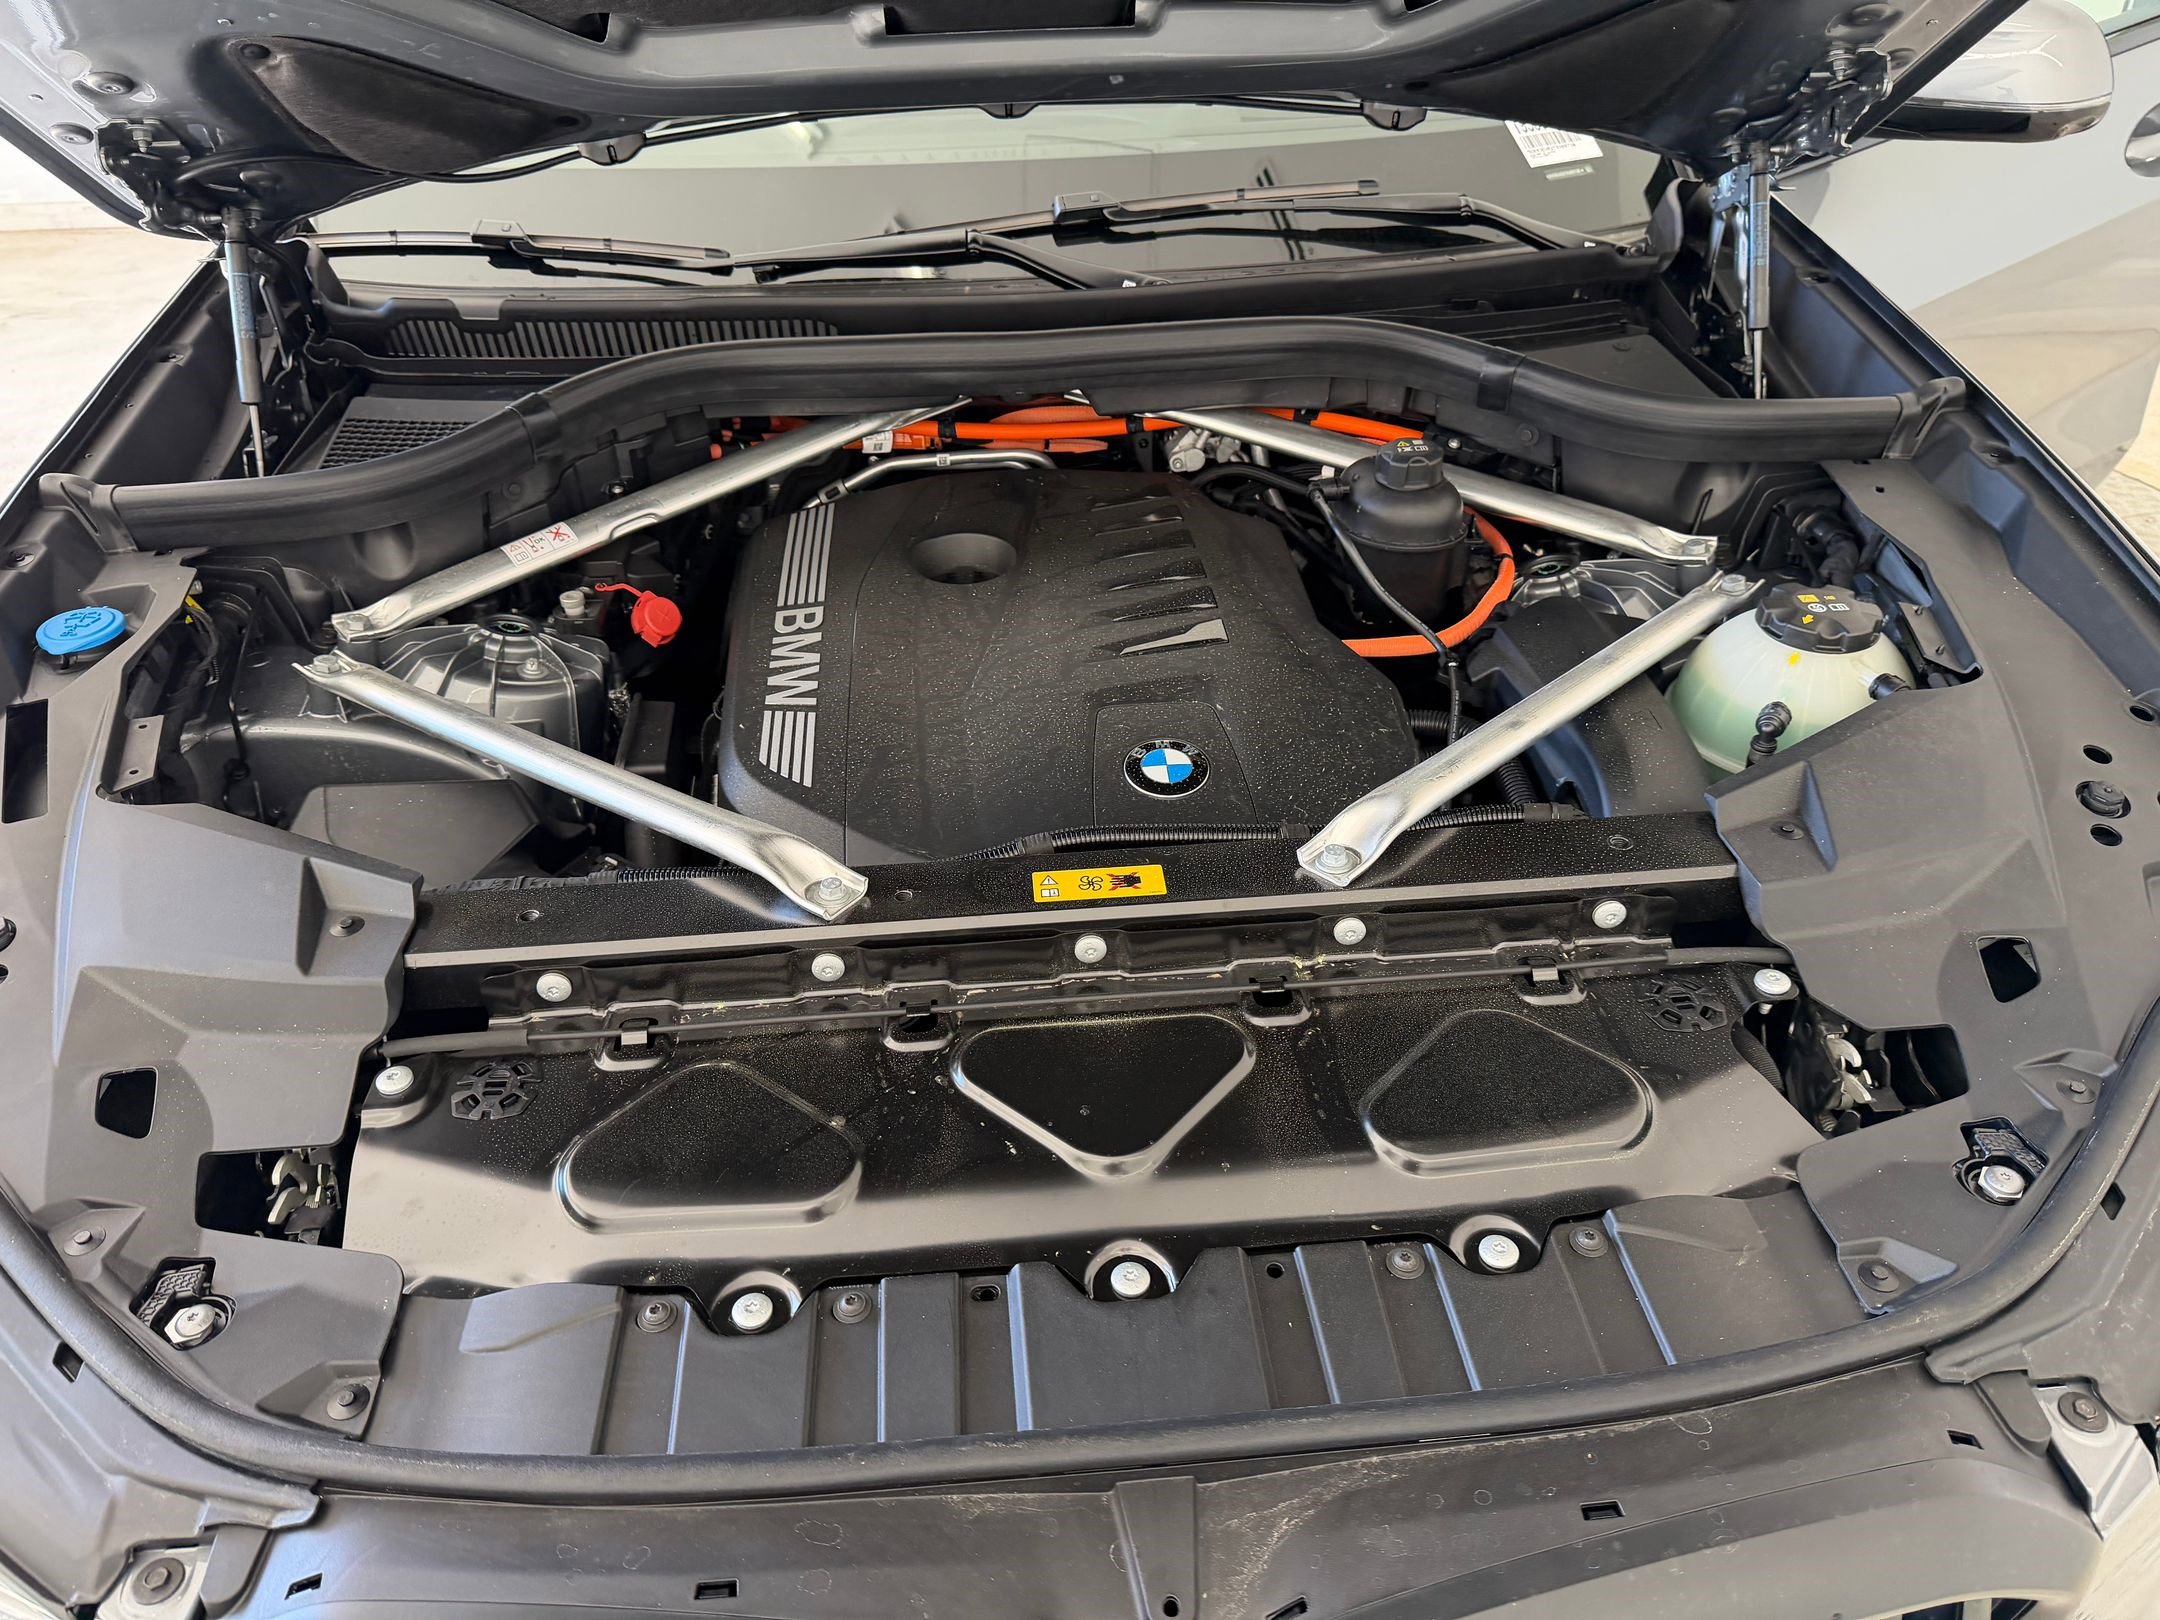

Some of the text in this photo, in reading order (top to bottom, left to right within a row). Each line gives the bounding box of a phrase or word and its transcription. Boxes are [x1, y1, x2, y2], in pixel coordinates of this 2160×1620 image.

[534, 537, 546, 545] OK
[764, 605, 825, 706] BMW
[1131, 739, 1199, 759] BMW
